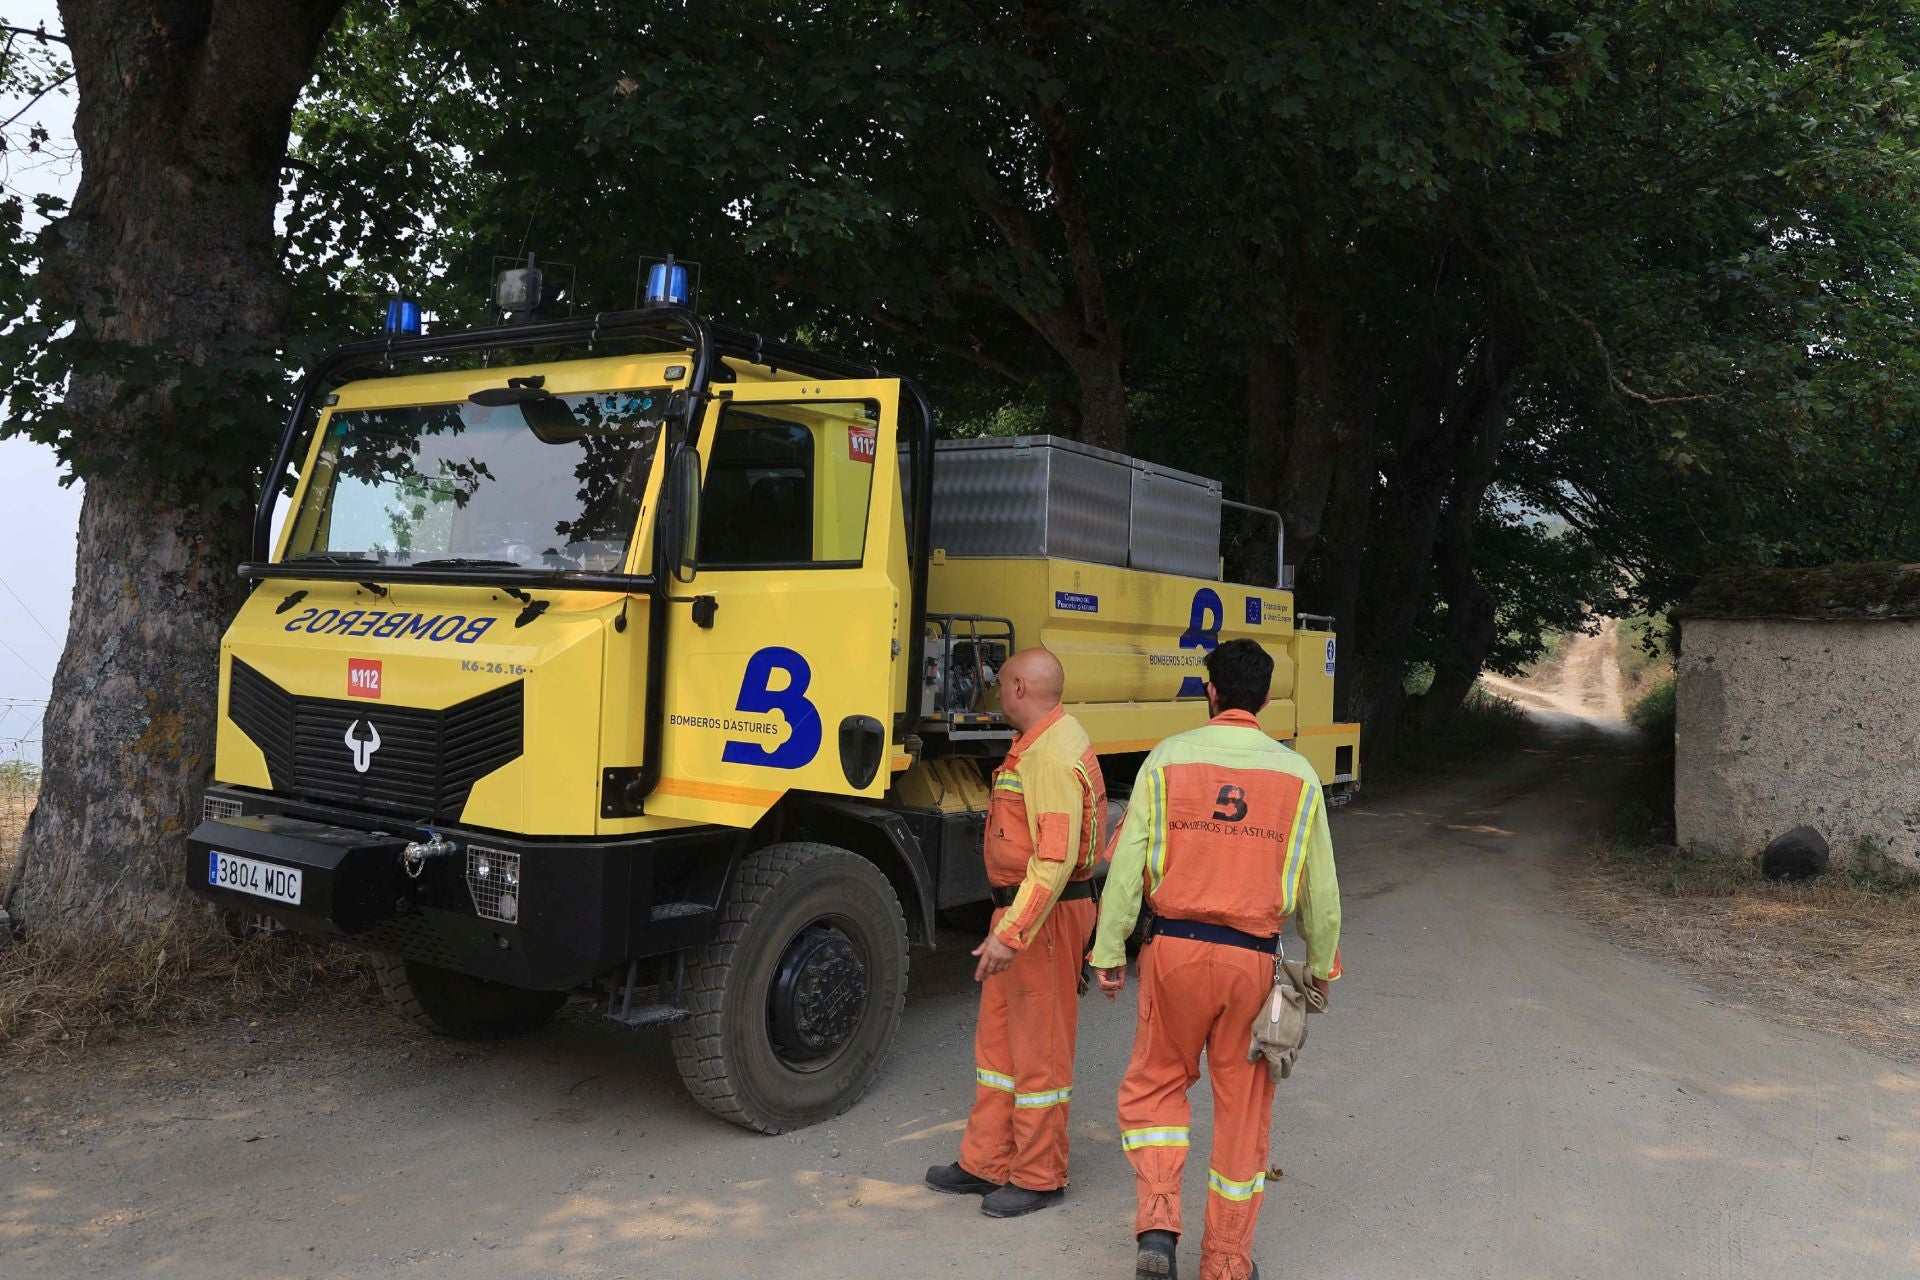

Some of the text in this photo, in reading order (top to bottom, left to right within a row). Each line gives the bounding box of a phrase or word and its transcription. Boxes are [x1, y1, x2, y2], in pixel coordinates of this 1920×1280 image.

[461, 660, 523, 676] K6-26.16
[1149, 654, 1180, 666] BOMBEROS
[358, 670, 379, 689] 112
[670, 714, 721, 729] BOMBEROS
[1169, 820, 1221, 833] BOMBEROS
[1224, 825, 1238, 836] DE
[219, 858, 297, 899] 3804 MDC
